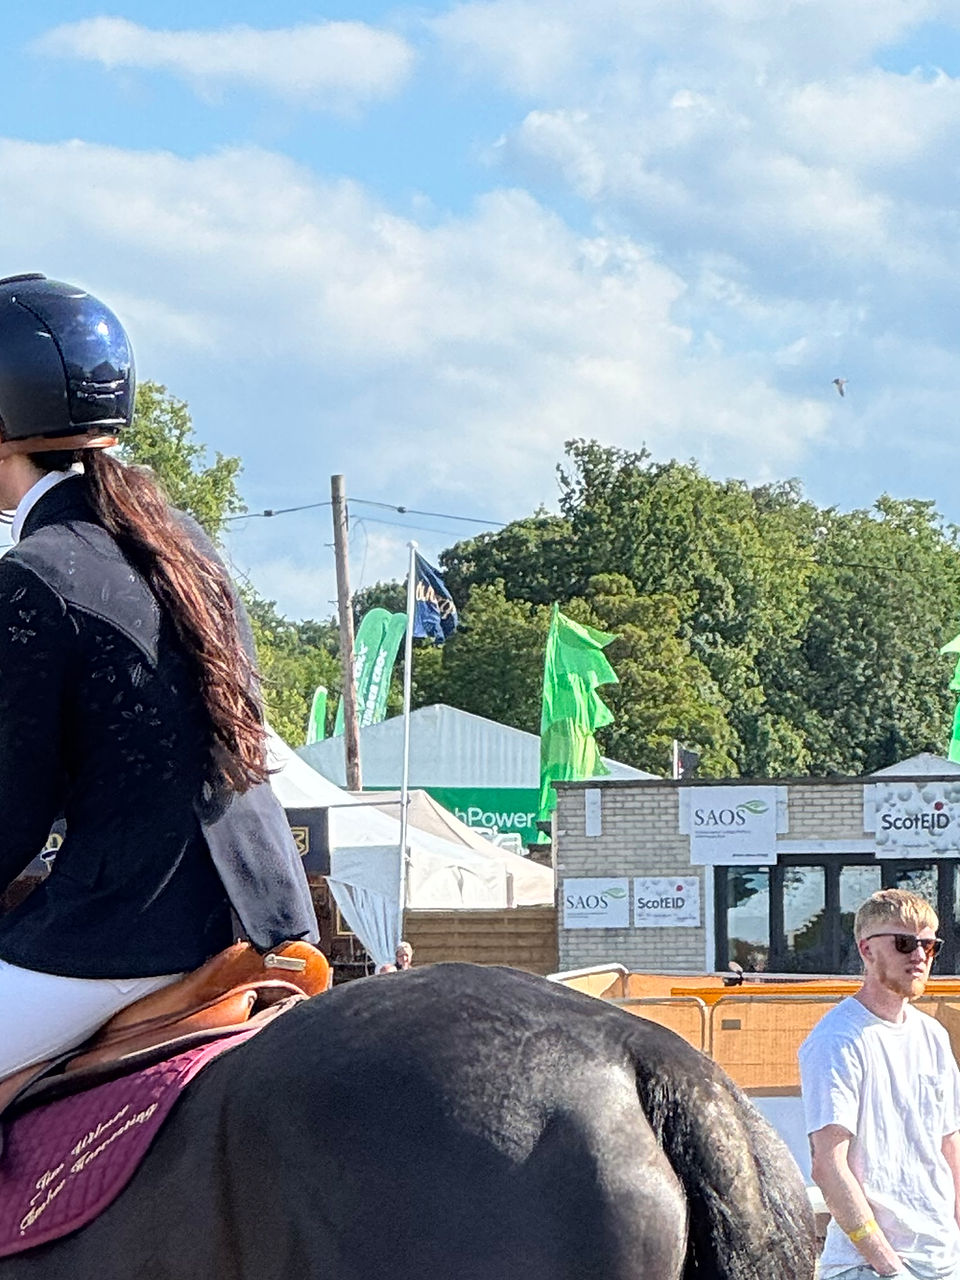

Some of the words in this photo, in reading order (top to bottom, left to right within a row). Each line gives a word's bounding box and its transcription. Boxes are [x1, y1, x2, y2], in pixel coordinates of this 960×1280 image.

[694, 808, 746, 827] SAOS
[881, 812, 950, 830] ScotEID
[566, 894, 609, 910] SAOS
[637, 896, 685, 910] ScotEID
